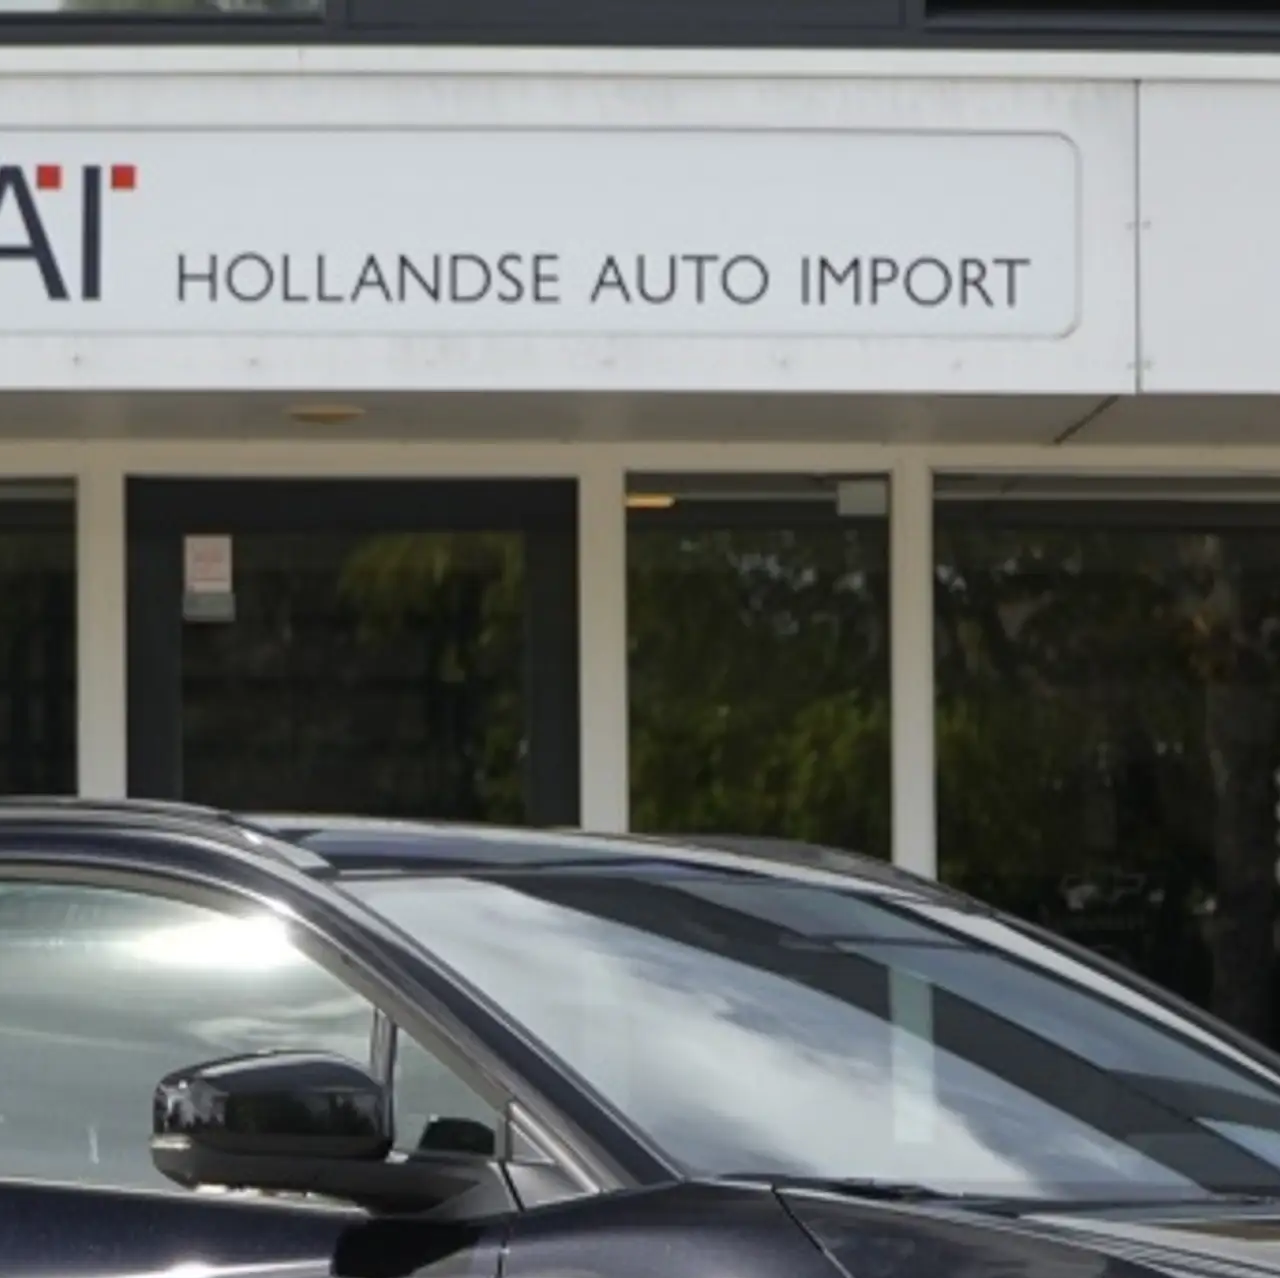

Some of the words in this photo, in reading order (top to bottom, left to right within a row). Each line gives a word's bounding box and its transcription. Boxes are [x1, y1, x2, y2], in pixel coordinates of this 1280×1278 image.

[178, 252, 560, 303] HOLLANDSE
[590, 254, 769, 304] AUTO
[801, 256, 1030, 306] IMPORT
